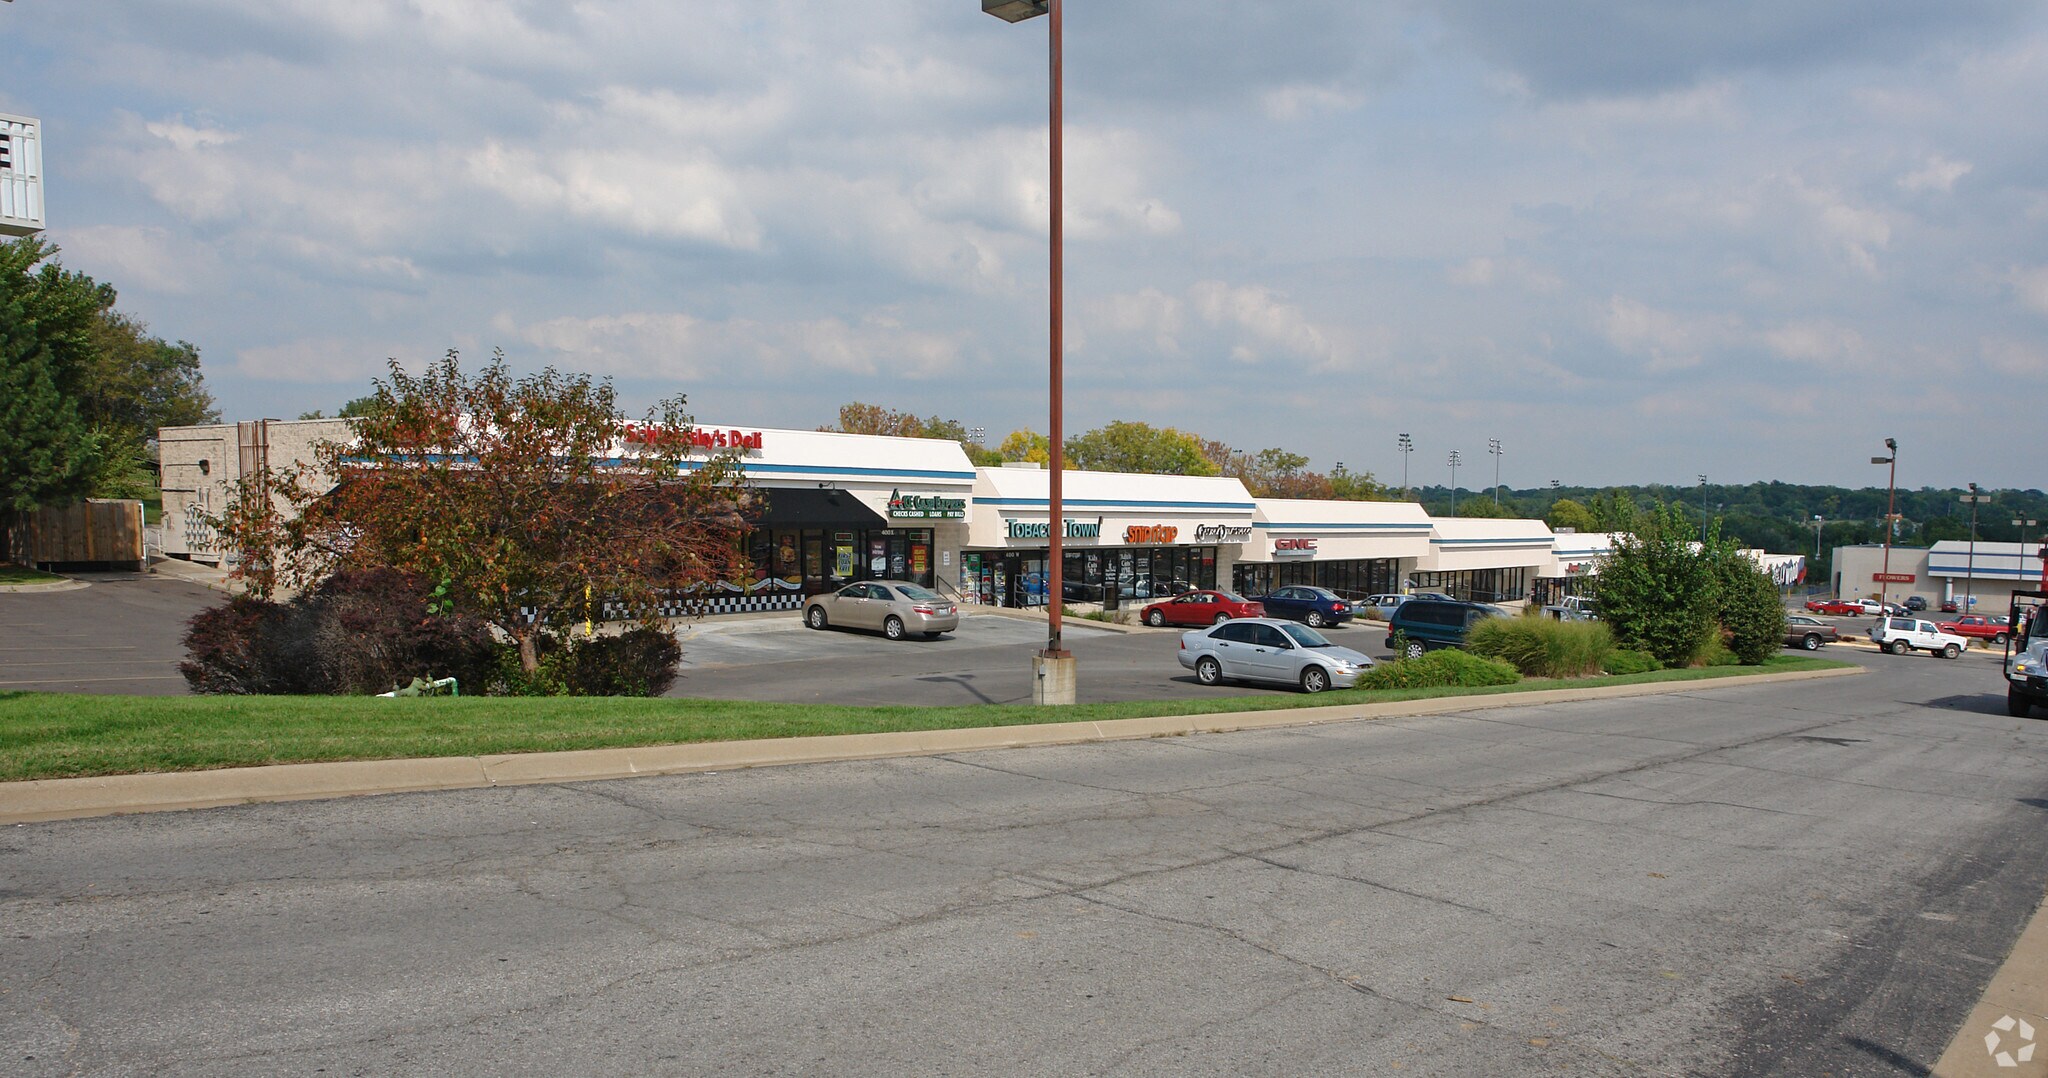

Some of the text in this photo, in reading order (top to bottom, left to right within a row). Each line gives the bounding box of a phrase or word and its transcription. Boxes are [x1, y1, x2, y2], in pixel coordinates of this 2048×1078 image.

[729, 430, 763, 449] Deli
[887, 488, 913, 509] ACE
[934, 496, 966, 509] EXPRESS
[1005, 518, 1064, 538] TOBAC
[1275, 538, 1318, 549] GNC
